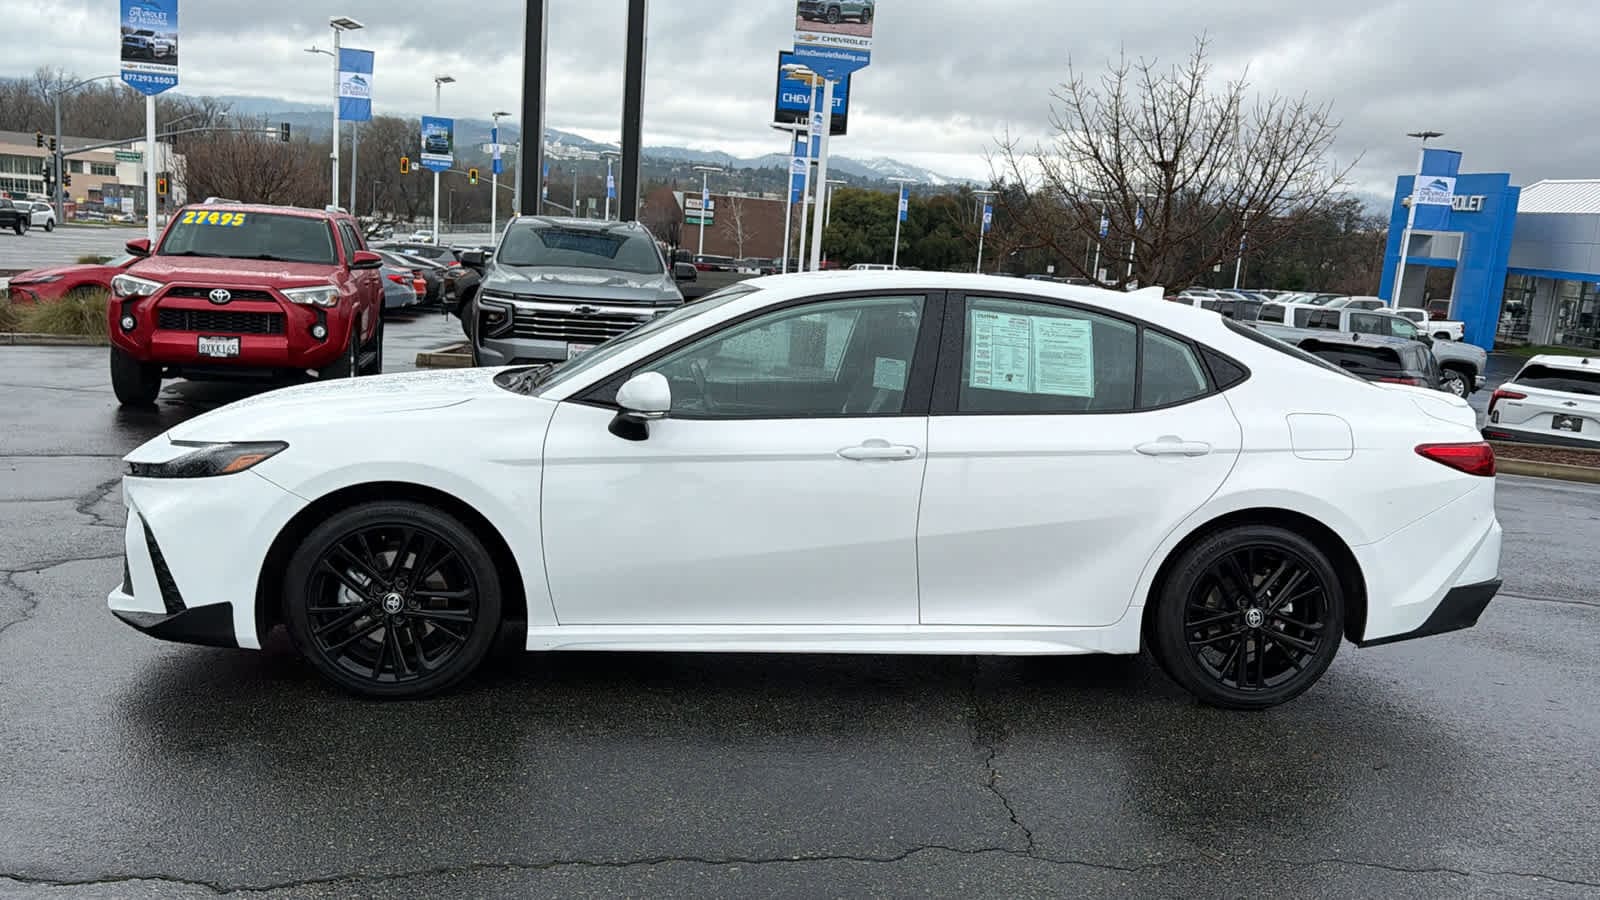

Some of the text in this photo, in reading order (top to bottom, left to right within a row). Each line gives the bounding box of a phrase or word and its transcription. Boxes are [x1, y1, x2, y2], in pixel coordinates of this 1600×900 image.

[822, 36, 869, 46] CHEVROLET
[795, 48, 868, 62] LithiaChevroletRedding.com
[782, 93, 842, 107] CHEVET
[1452, 195, 1487, 211] ROLET
[182, 211, 246, 226] 27495
